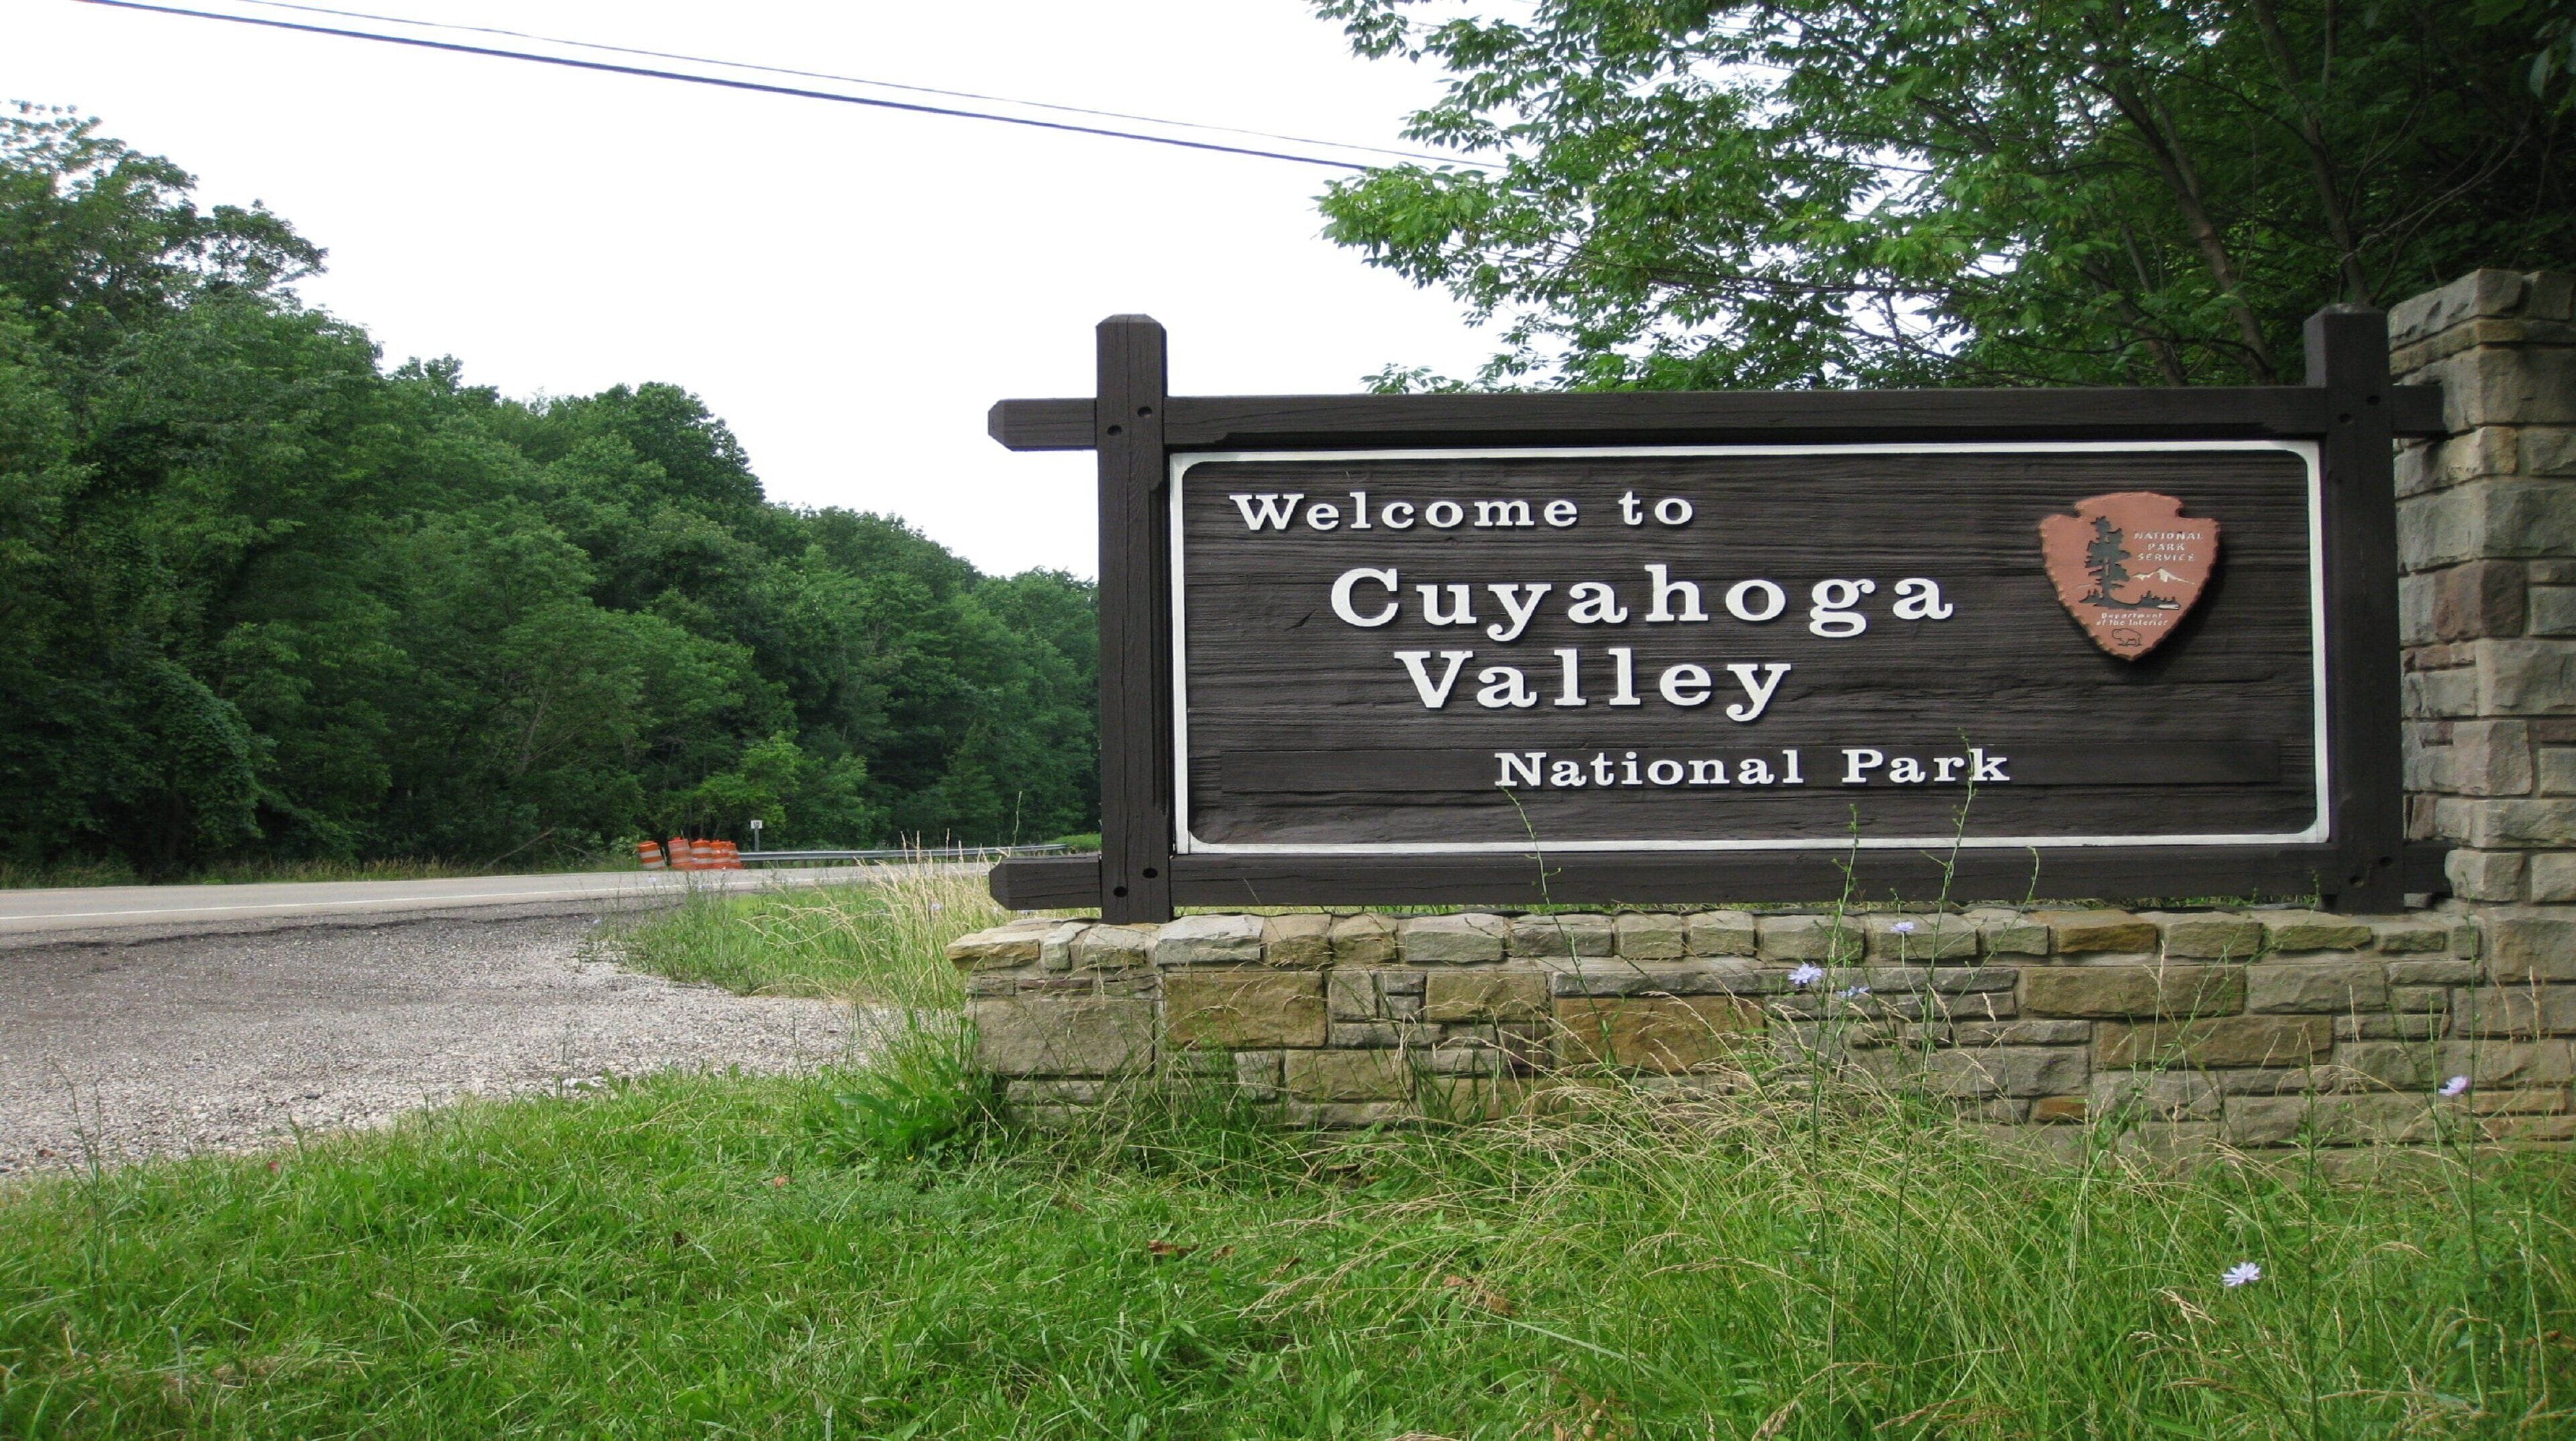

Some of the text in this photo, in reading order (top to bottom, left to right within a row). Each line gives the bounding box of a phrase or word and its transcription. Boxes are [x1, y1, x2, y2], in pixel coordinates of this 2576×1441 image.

[1228, 490, 1693, 531] Welcome to
[2134, 531, 2204, 540] NATIONAL
[2147, 543, 2185, 551] PARK
[2137, 553, 2195, 561] SERVICE
[1330, 563, 1953, 642] Cuyahoga
[1393, 647, 1792, 723] Valley
[1493, 747, 2011, 787] National Park
